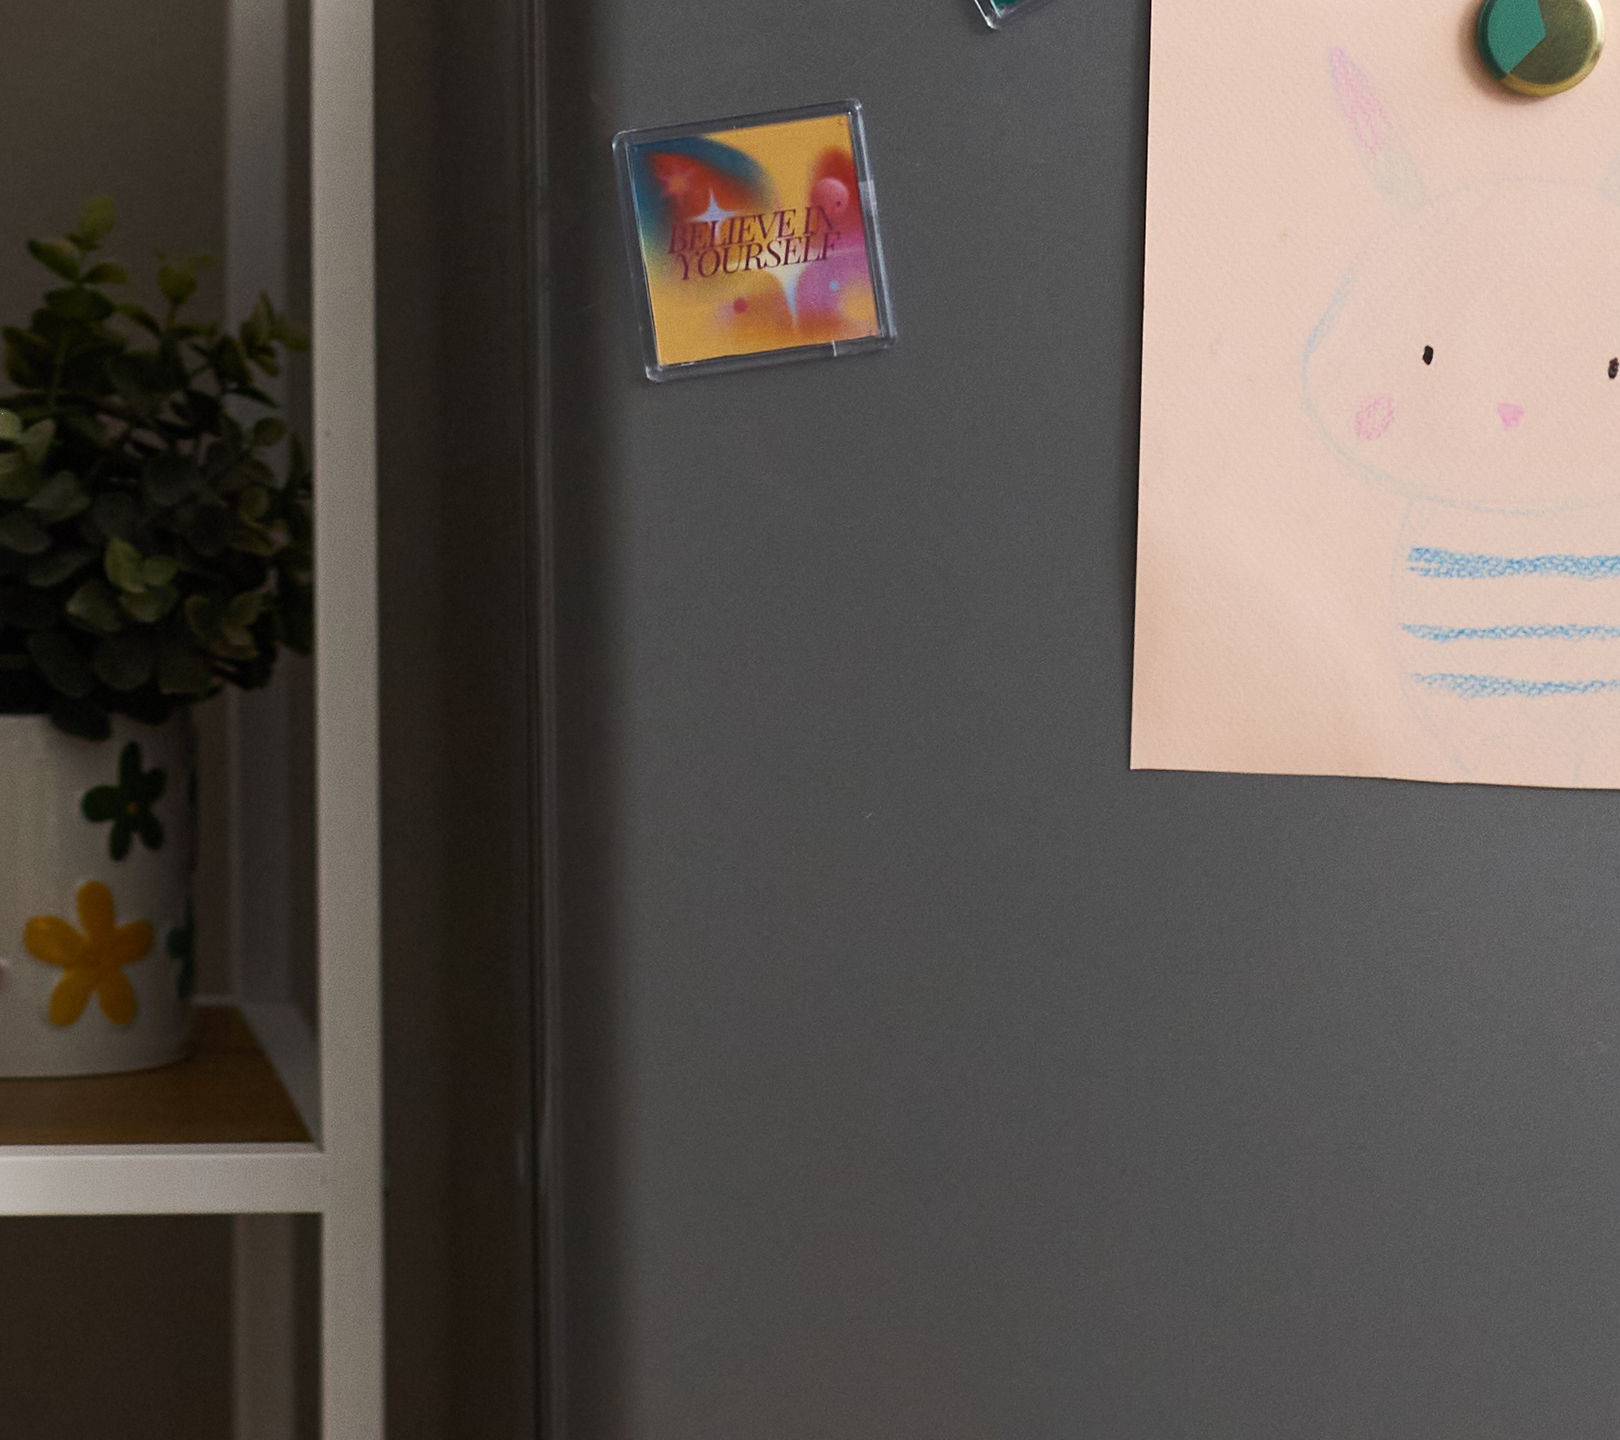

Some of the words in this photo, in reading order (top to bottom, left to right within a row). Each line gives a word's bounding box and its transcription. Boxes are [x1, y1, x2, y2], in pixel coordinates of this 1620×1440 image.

[668, 207, 796, 256] BELIEVE
[803, 205, 835, 235] IN
[677, 231, 841, 281] YOURSELF
